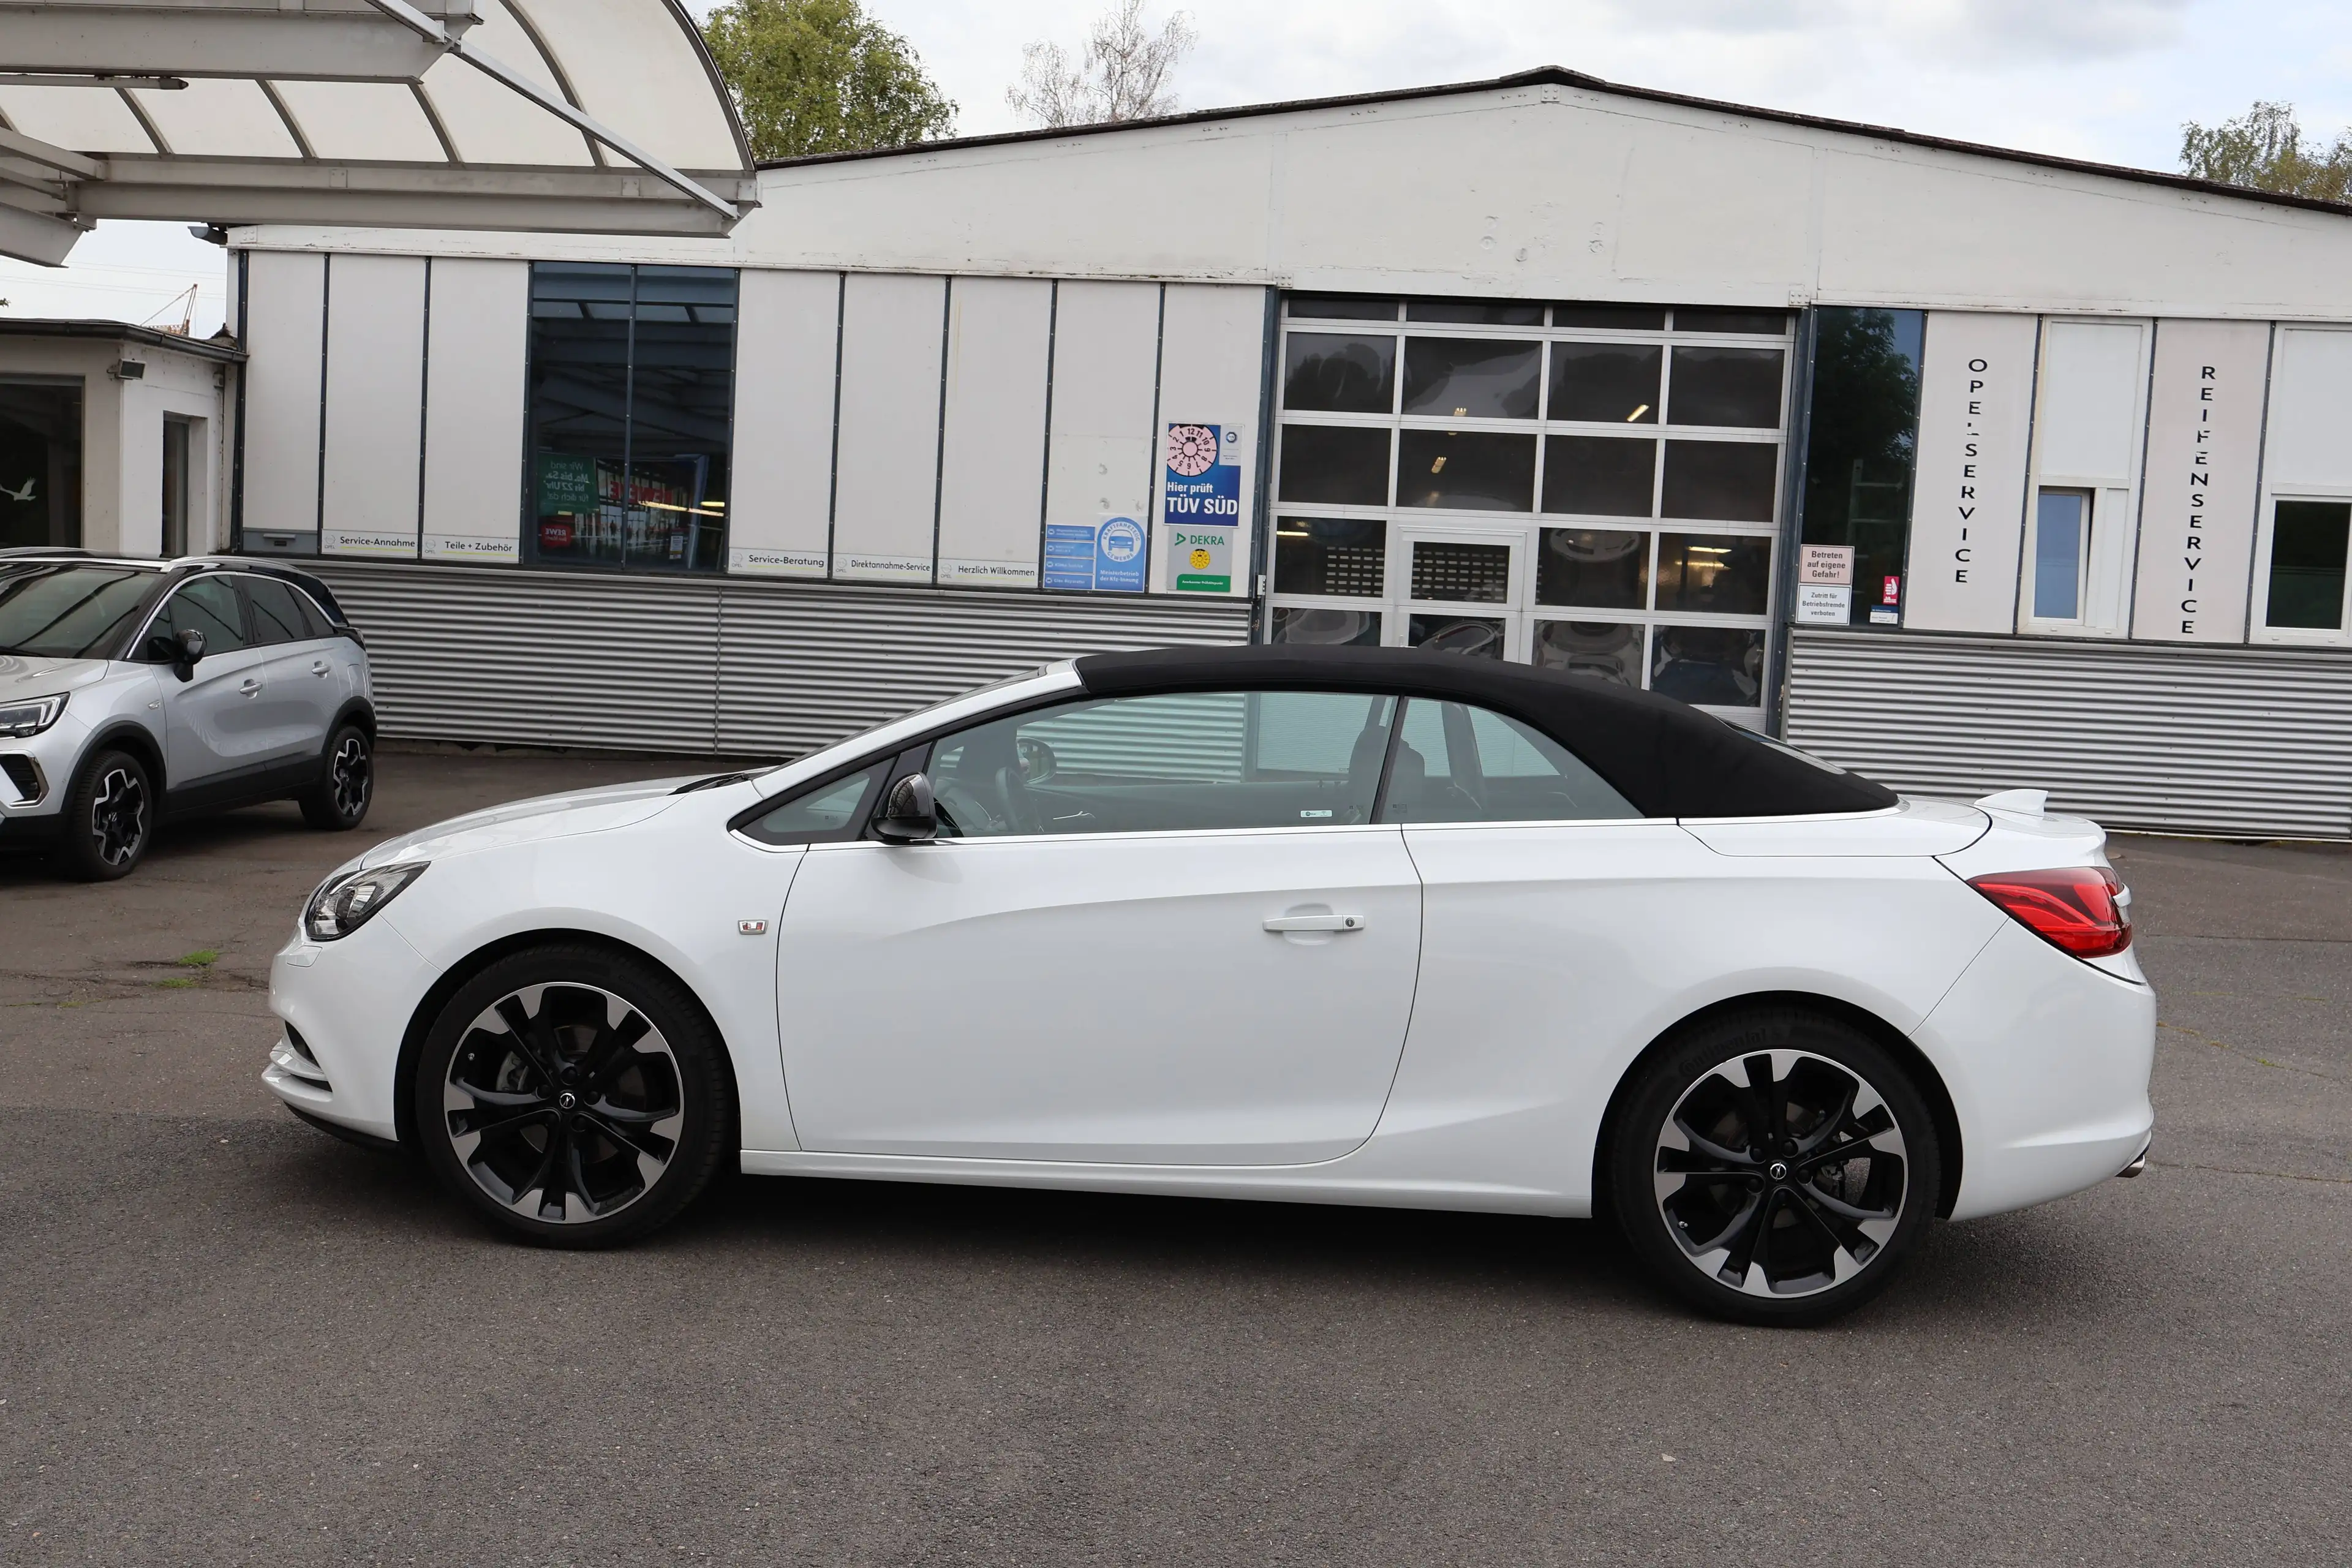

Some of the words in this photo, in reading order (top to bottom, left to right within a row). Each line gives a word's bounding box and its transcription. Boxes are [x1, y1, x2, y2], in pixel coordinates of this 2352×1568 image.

[1167, 481, 1188, 492] Hier
[1190, 483, 1213, 495] prüft
[1166, 494, 1200, 513] TÜV
[1204, 496, 1238, 515] SÜD
[2180, 366, 2217, 635] REIFENSERVICE
[1102, 522, 1140, 541] KRAFTFAHRZEUG
[340, 536, 415, 547] Service-Annahme
[445, 541, 466, 549] Teile
[475, 543, 513, 552] Zubehör
[1190, 535, 1225, 546] DEKRA
[748, 554, 824, 568] Service-Beratung
[851, 559, 930, 571] Direktannahme-Service
[958, 565, 988, 574] Herzlich
[990, 566, 1035, 576] Willkommen
[1812, 570, 1839, 578] Gefahr!
